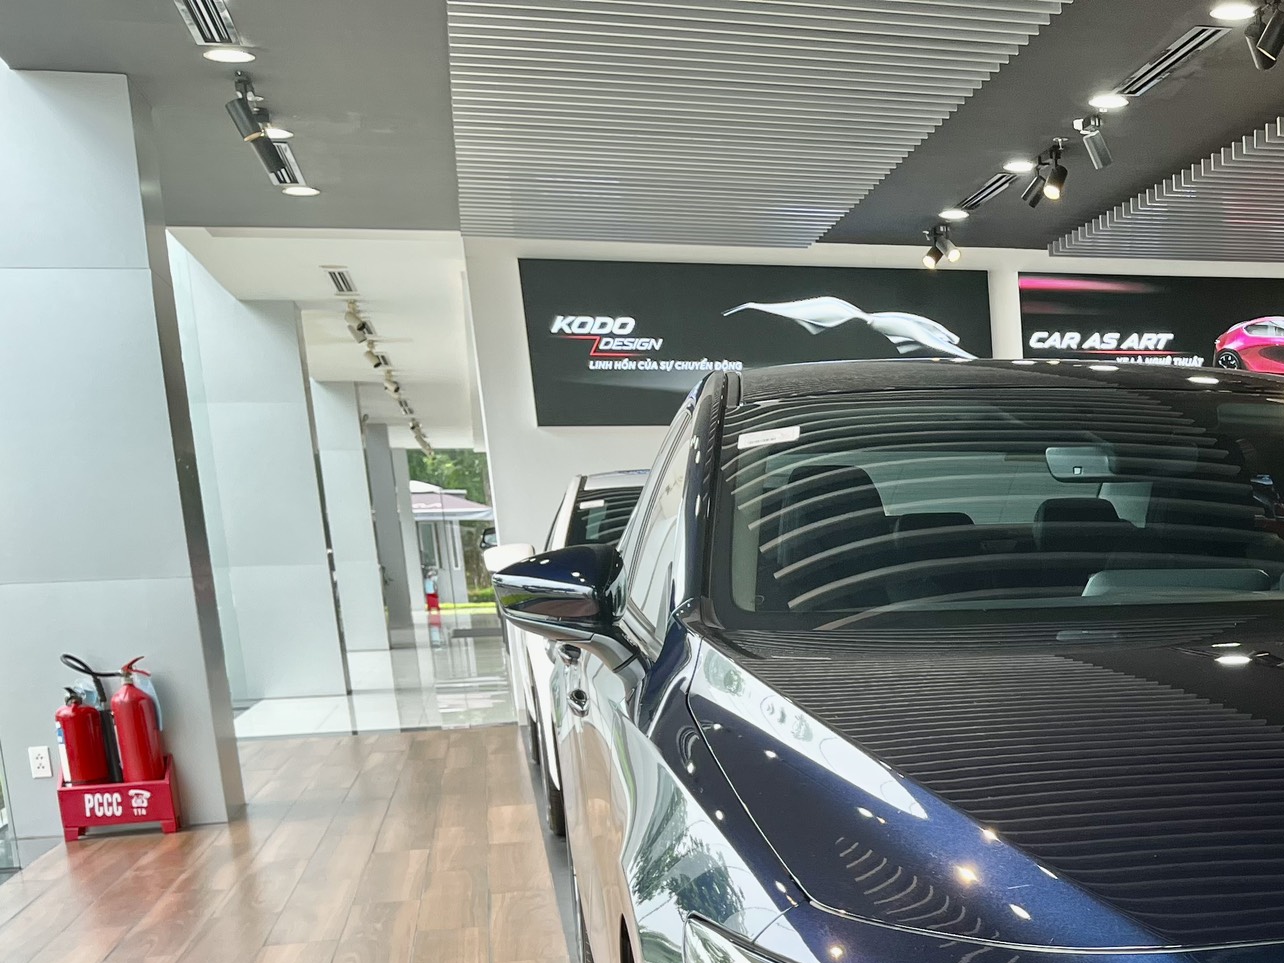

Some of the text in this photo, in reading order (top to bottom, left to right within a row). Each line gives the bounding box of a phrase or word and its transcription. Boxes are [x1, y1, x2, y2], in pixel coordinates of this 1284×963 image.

[550, 315, 636, 335] KODO
[598, 338, 663, 350] DESIGN
[1029, 331, 1174, 350] CAR AS ART
[589, 360, 613, 370] LINH
[84, 792, 122, 817] PCCC
